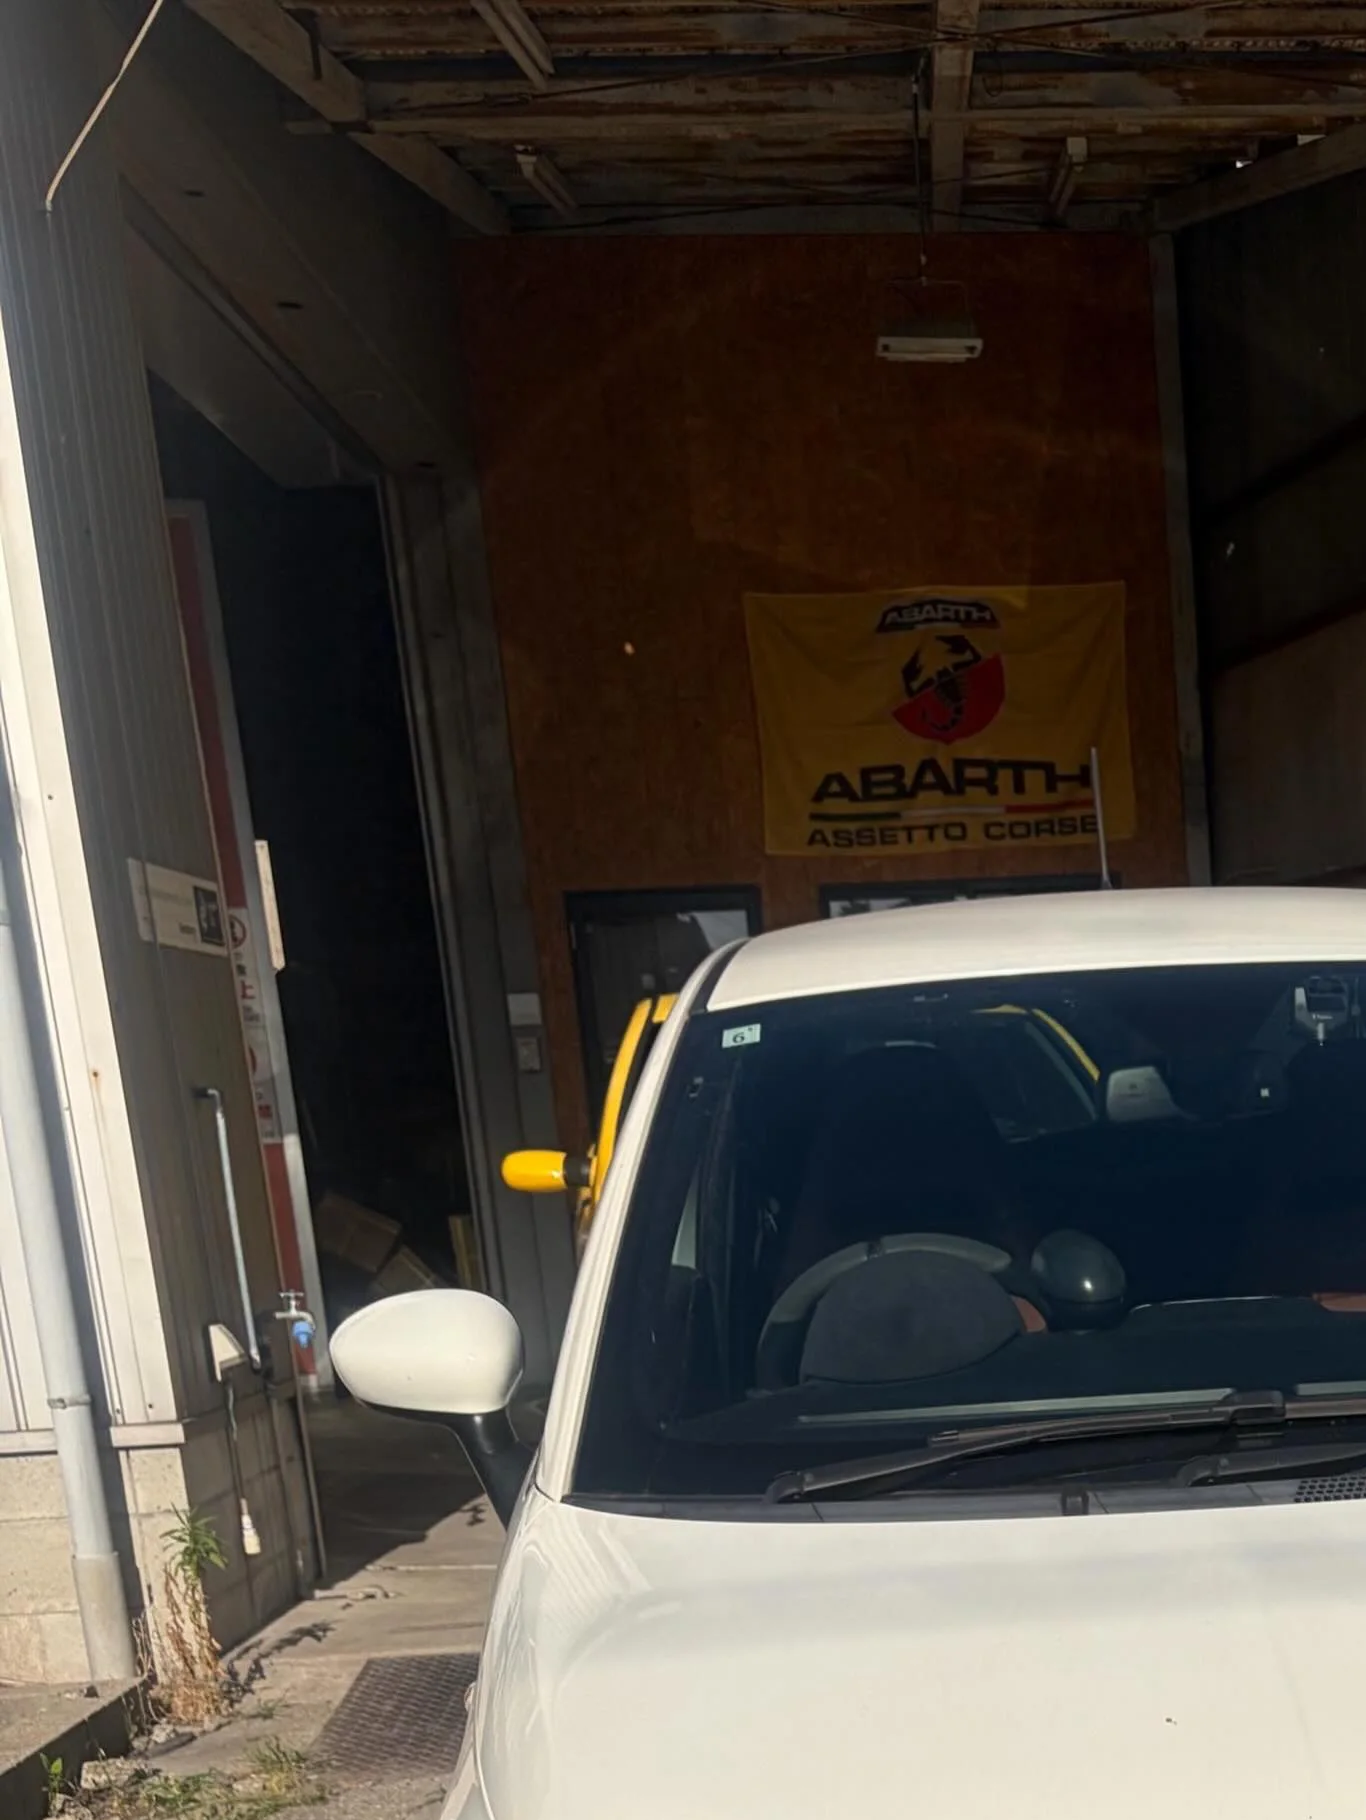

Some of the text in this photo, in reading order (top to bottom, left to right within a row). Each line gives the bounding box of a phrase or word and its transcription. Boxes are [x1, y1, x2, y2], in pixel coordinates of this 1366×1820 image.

[884, 604, 992, 624] ABARTH
[810, 758, 1092, 804] ABARTH
[806, 813, 1099, 849] ASSETTO CORSE
